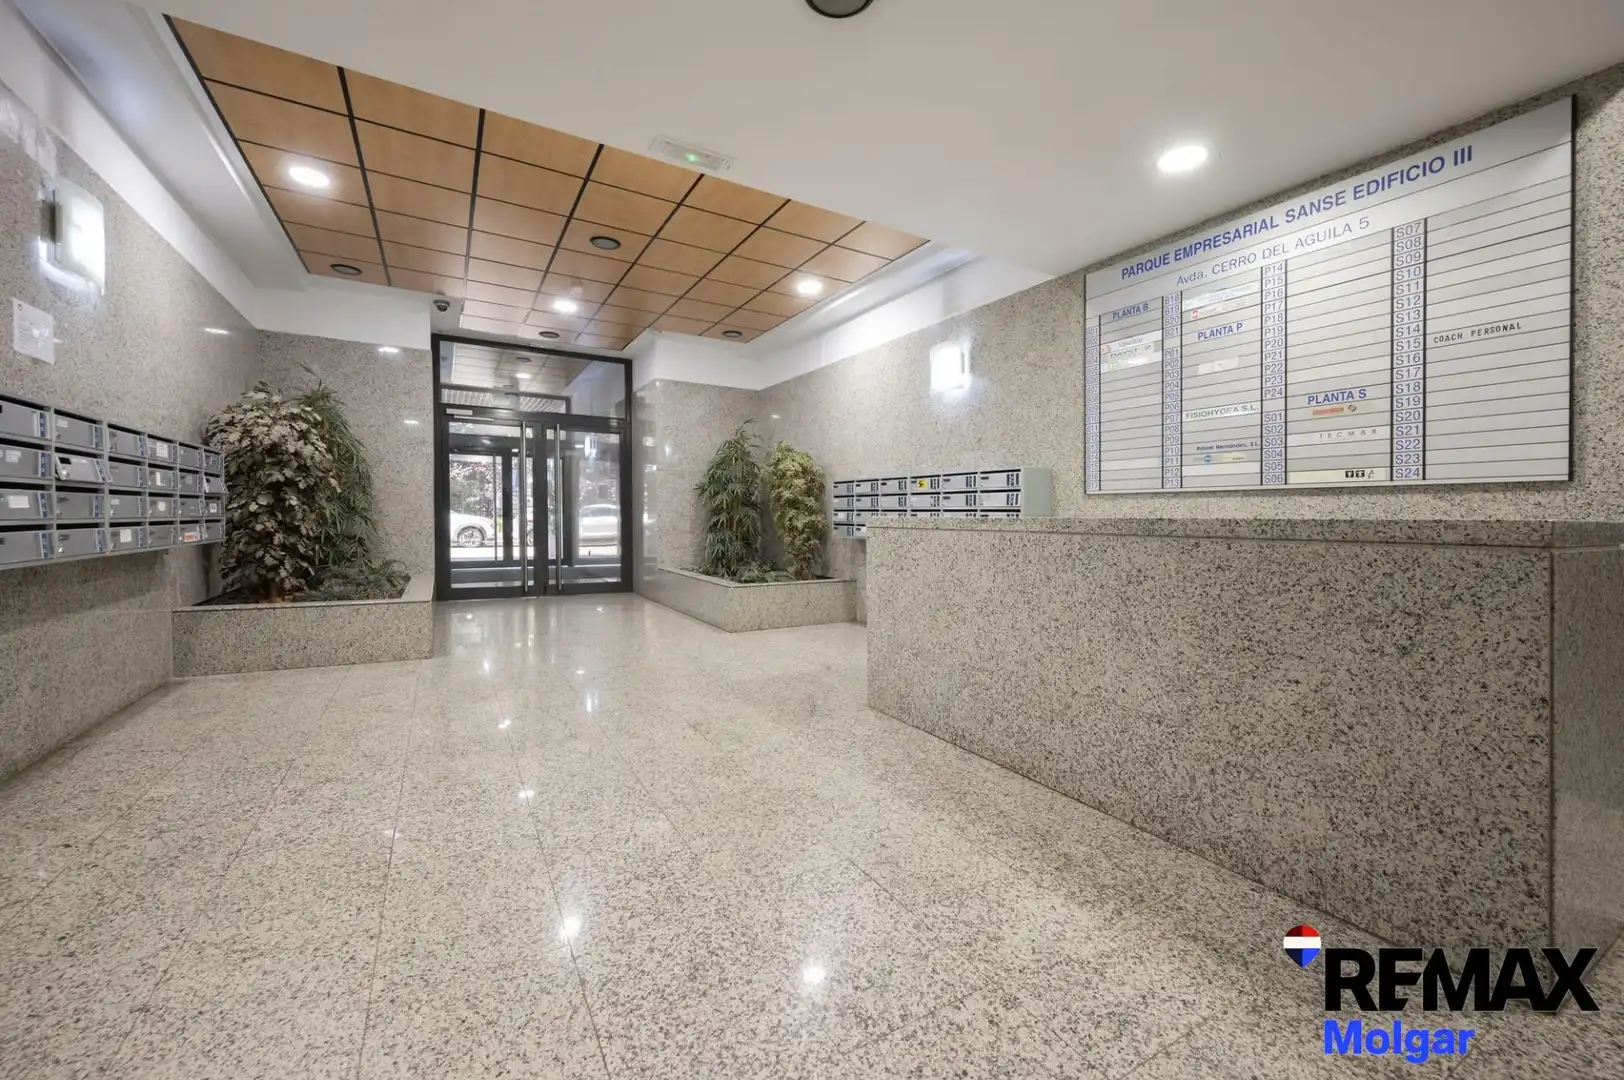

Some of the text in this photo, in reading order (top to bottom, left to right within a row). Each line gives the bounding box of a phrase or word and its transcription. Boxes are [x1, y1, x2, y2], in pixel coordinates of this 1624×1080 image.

[1121, 145, 1473, 280] PARQUE EMPRESARIAL SANSE EDIFICIO III
[1396, 222, 1421, 238] S07
[1396, 236, 1421, 253] S08
[1176, 216, 1370, 286] Avda. CERRO DEL AGUILA 5
[1396, 251, 1421, 267] S09
[1264, 264, 1283, 276] P14
[1396, 266, 1421, 281] S10
[1264, 276, 1283, 288] P15
[1396, 280, 1421, 295] S11
[1264, 288, 1283, 301] P16
[1264, 300, 1283, 313] P17
[1396, 295, 1421, 309] S12
[1112, 304, 1149, 320] PLANTA B
[1396, 309, 1421, 324] S13
[1264, 313, 1283, 325] P18
[1197, 322, 1243, 340] PLANTA P
[1264, 326, 1283, 337] P19
[1396, 323, 1421, 338] S14
[1433, 322, 1522, 344] COACH PERSONAL
[1264, 339, 1283, 350] P20
[1396, 338, 1421, 352] S15
[1165, 349, 1179, 358] P01
[1264, 351, 1283, 362] P21
[1396, 352, 1421, 366] S16
[1165, 360, 1179, 369] P02
[1264, 363, 1283, 373] P22
[1165, 371, 1179, 380] P03
[1396, 367, 1421, 380] S17
[1264, 375, 1283, 385] P23
[1165, 382, 1179, 390] P04
[1396, 381, 1421, 394] S18
[1165, 393, 1179, 401] P05
[1264, 389, 1283, 398] P24
[1307, 388, 1367, 405] PLANTA S
[1396, 396, 1421, 408] S19
[1165, 414, 1179, 422] P07
[1264, 413, 1283, 422] S01
[1396, 410, 1421, 422] S20
[1165, 425, 1179, 433] P08
[1264, 425, 1283, 435] S02
[1396, 425, 1421, 436] S21
[1165, 436, 1179, 444] P09
[1264, 437, 1283, 447] S03
[1396, 439, 1421, 450] S22
[1165, 447, 1179, 455] P10
[1264, 449, 1283, 459] S04
[1396, 454, 1421, 465] S23
[1264, 462, 1283, 471] S05
[1264, 474, 1283, 483] S06
[1396, 468, 1421, 479] S24
[1165, 479, 1179, 487] P13
